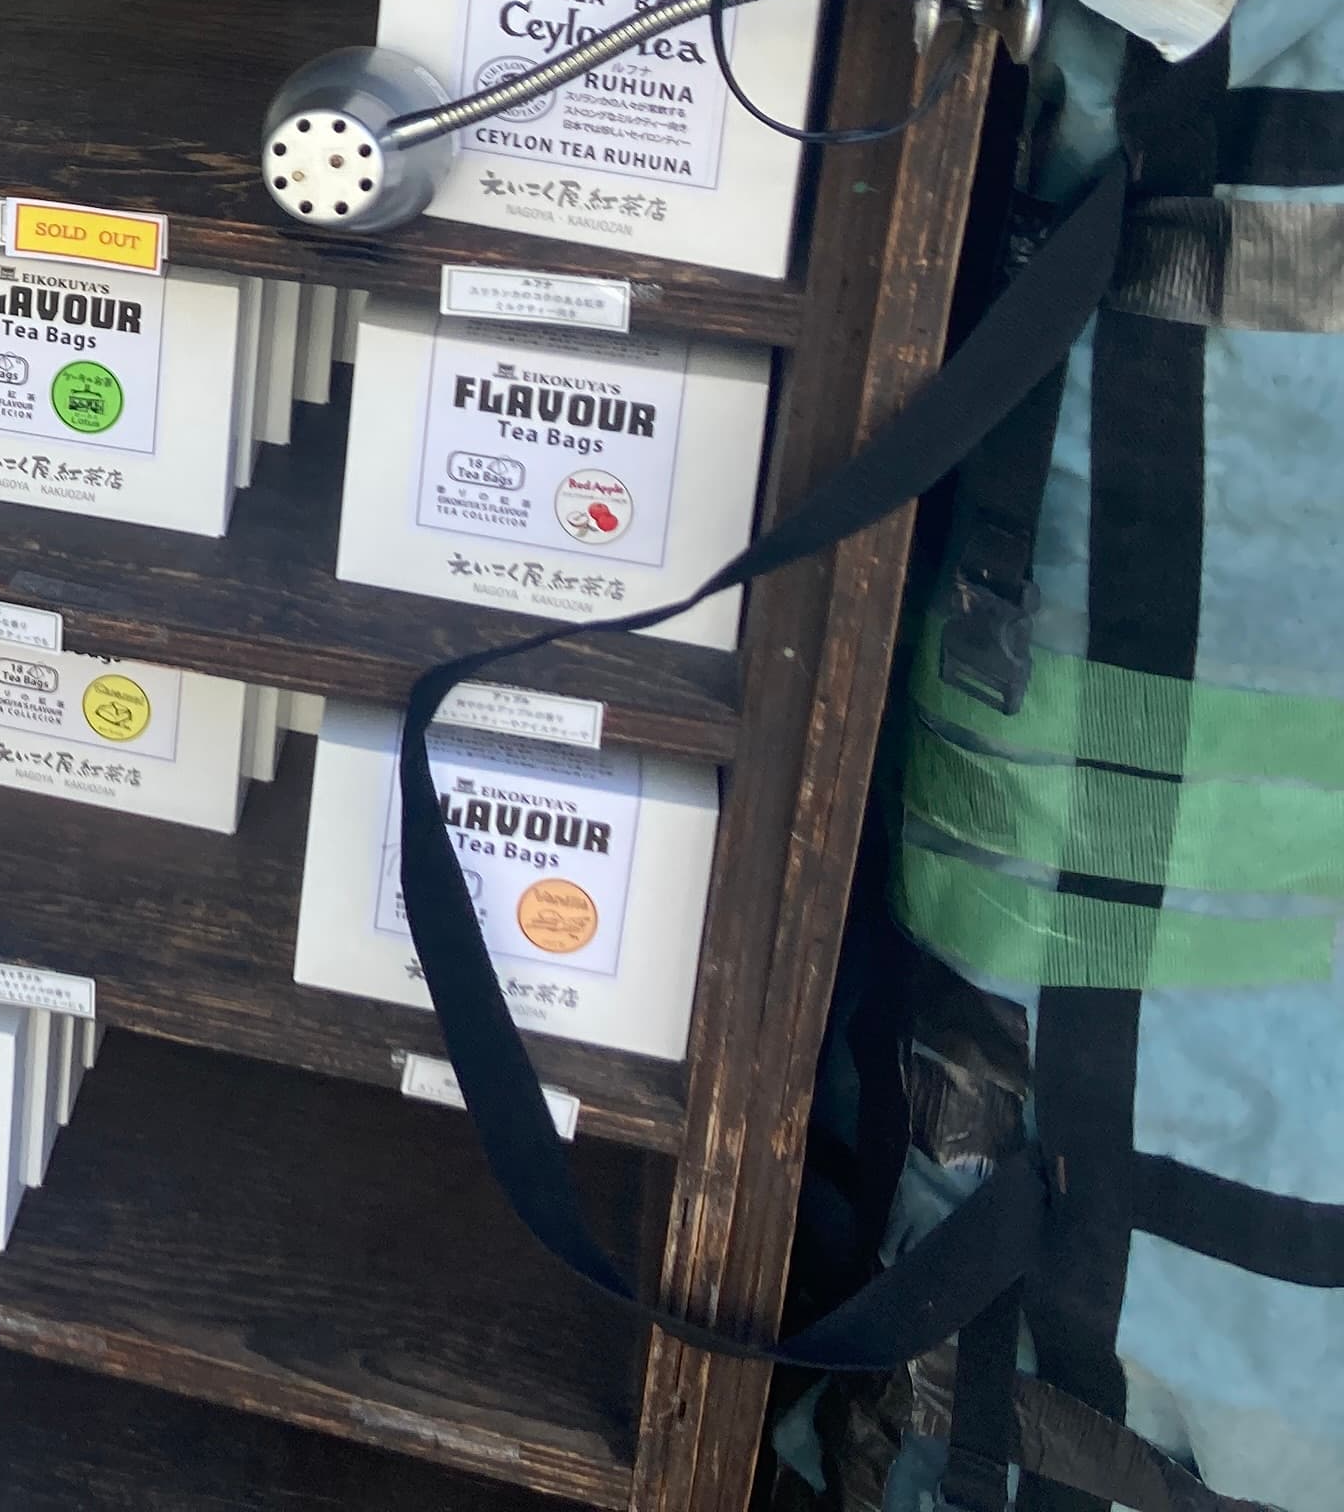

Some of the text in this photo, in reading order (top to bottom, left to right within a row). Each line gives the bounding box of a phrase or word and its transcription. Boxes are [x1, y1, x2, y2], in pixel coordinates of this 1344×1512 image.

[584, 71, 694, 104] RUHUNA
[475, 126, 693, 176] CEYLON TEA RUHUNA
[35, 221, 142, 250] SOLD OUT
[2, 319, 97, 352] Tea Bags
[452, 375, 656, 439] FLAVOUR
[497, 420, 604, 454] Tea Bags
[441, 793, 612, 855] LAVOUR
